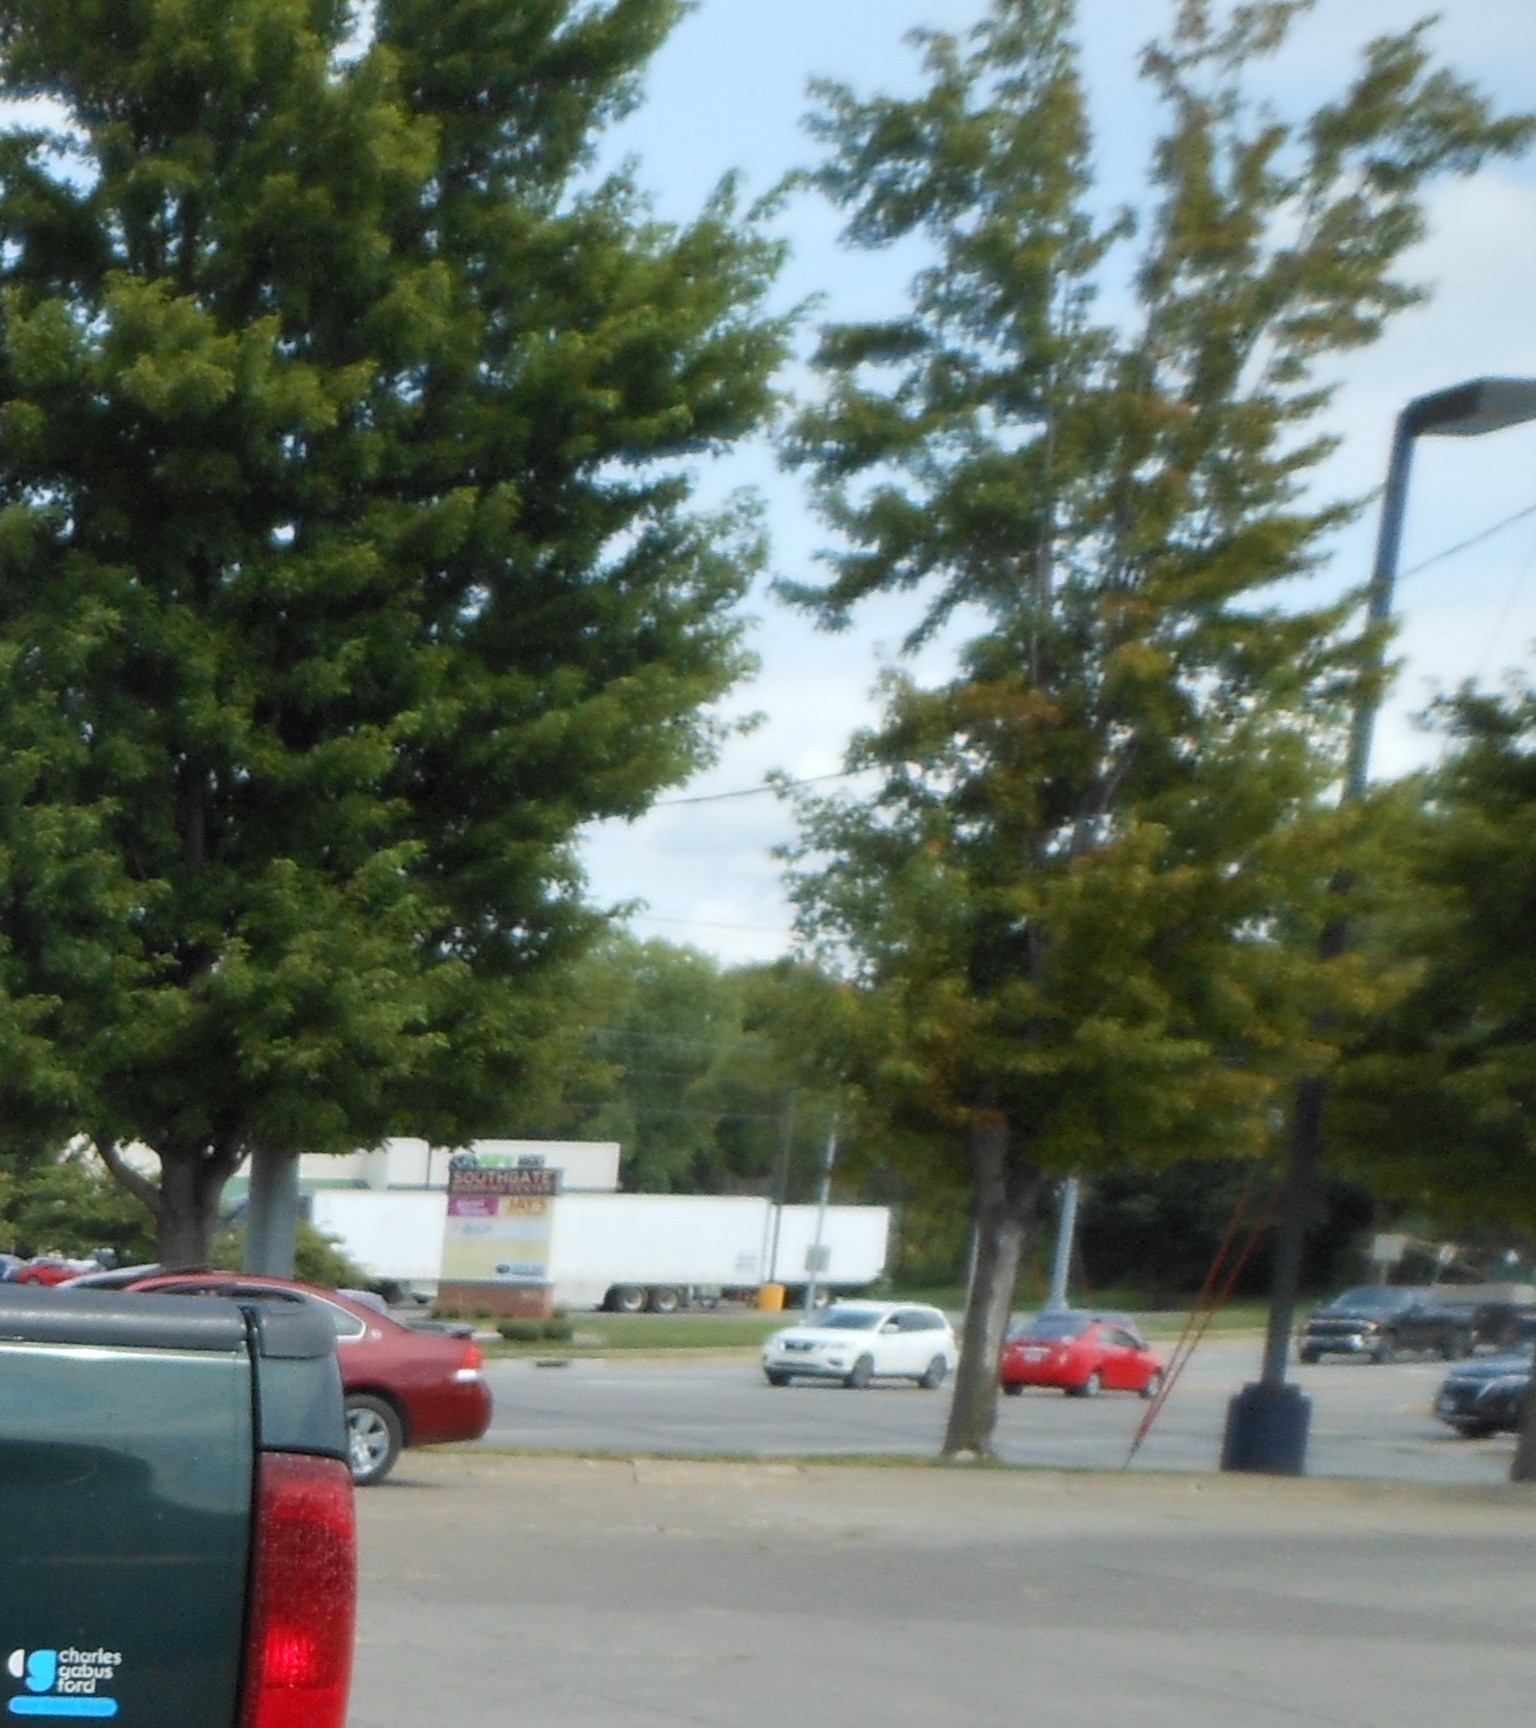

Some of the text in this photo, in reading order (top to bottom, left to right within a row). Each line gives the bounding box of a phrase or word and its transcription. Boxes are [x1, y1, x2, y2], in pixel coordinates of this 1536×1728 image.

[59, 1647, 122, 1665] charles
[59, 1665, 113, 1680] gabus
[59, 1678, 95, 1693] ford
